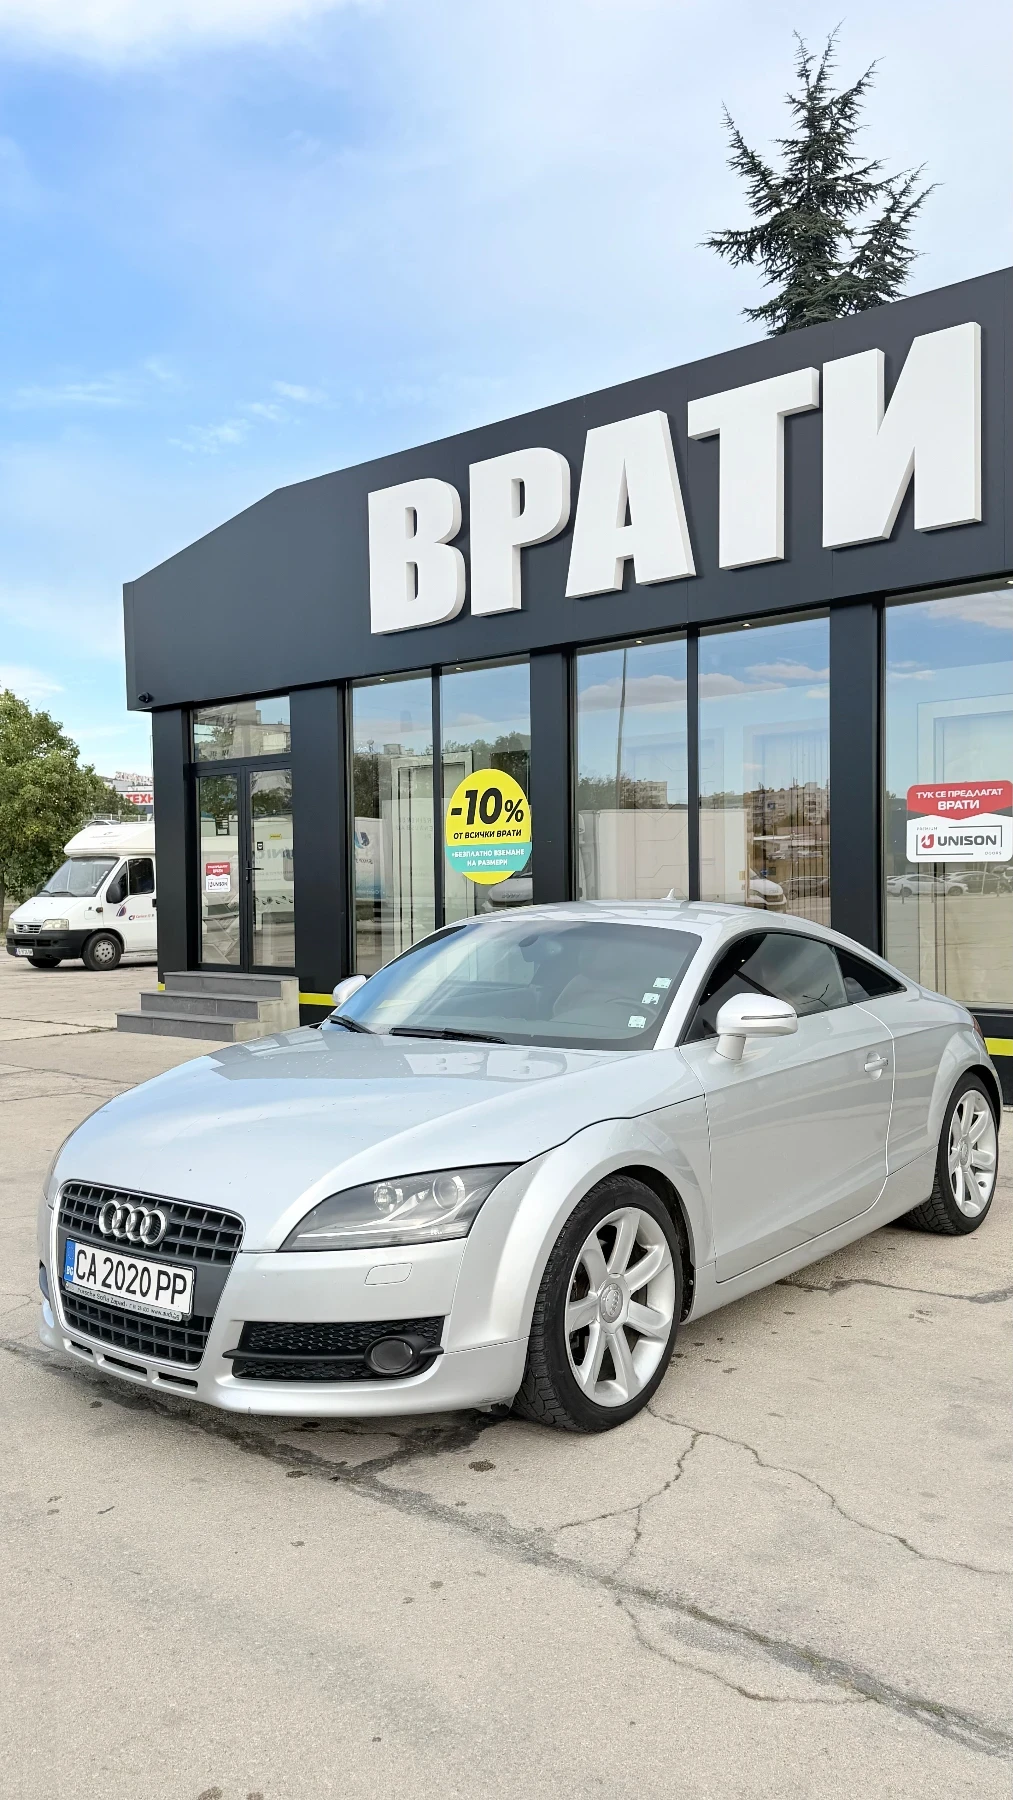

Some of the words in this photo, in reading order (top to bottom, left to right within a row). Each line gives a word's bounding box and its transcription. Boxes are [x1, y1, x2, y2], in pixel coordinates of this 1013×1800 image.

[368, 321, 982, 635] ВРАТИ
[916, 791, 934, 799] ТУК
[935, 790, 947, 798] СЕ
[948, 788, 1003, 797] ПРЕДЛАГАТ
[451, 787, 524, 825] -10%
[938, 799, 980, 810] ВРАТИ
[465, 830, 495, 839] ВСИЧКИ
[496, 829, 522, 838] ВРАТИ
[938, 835, 997, 846] UNISON
[477, 858, 508, 866] РАЗМЕРИ
[66, 1265, 74, 1276] BG
[101, 1257, 151, 1297] 2020
